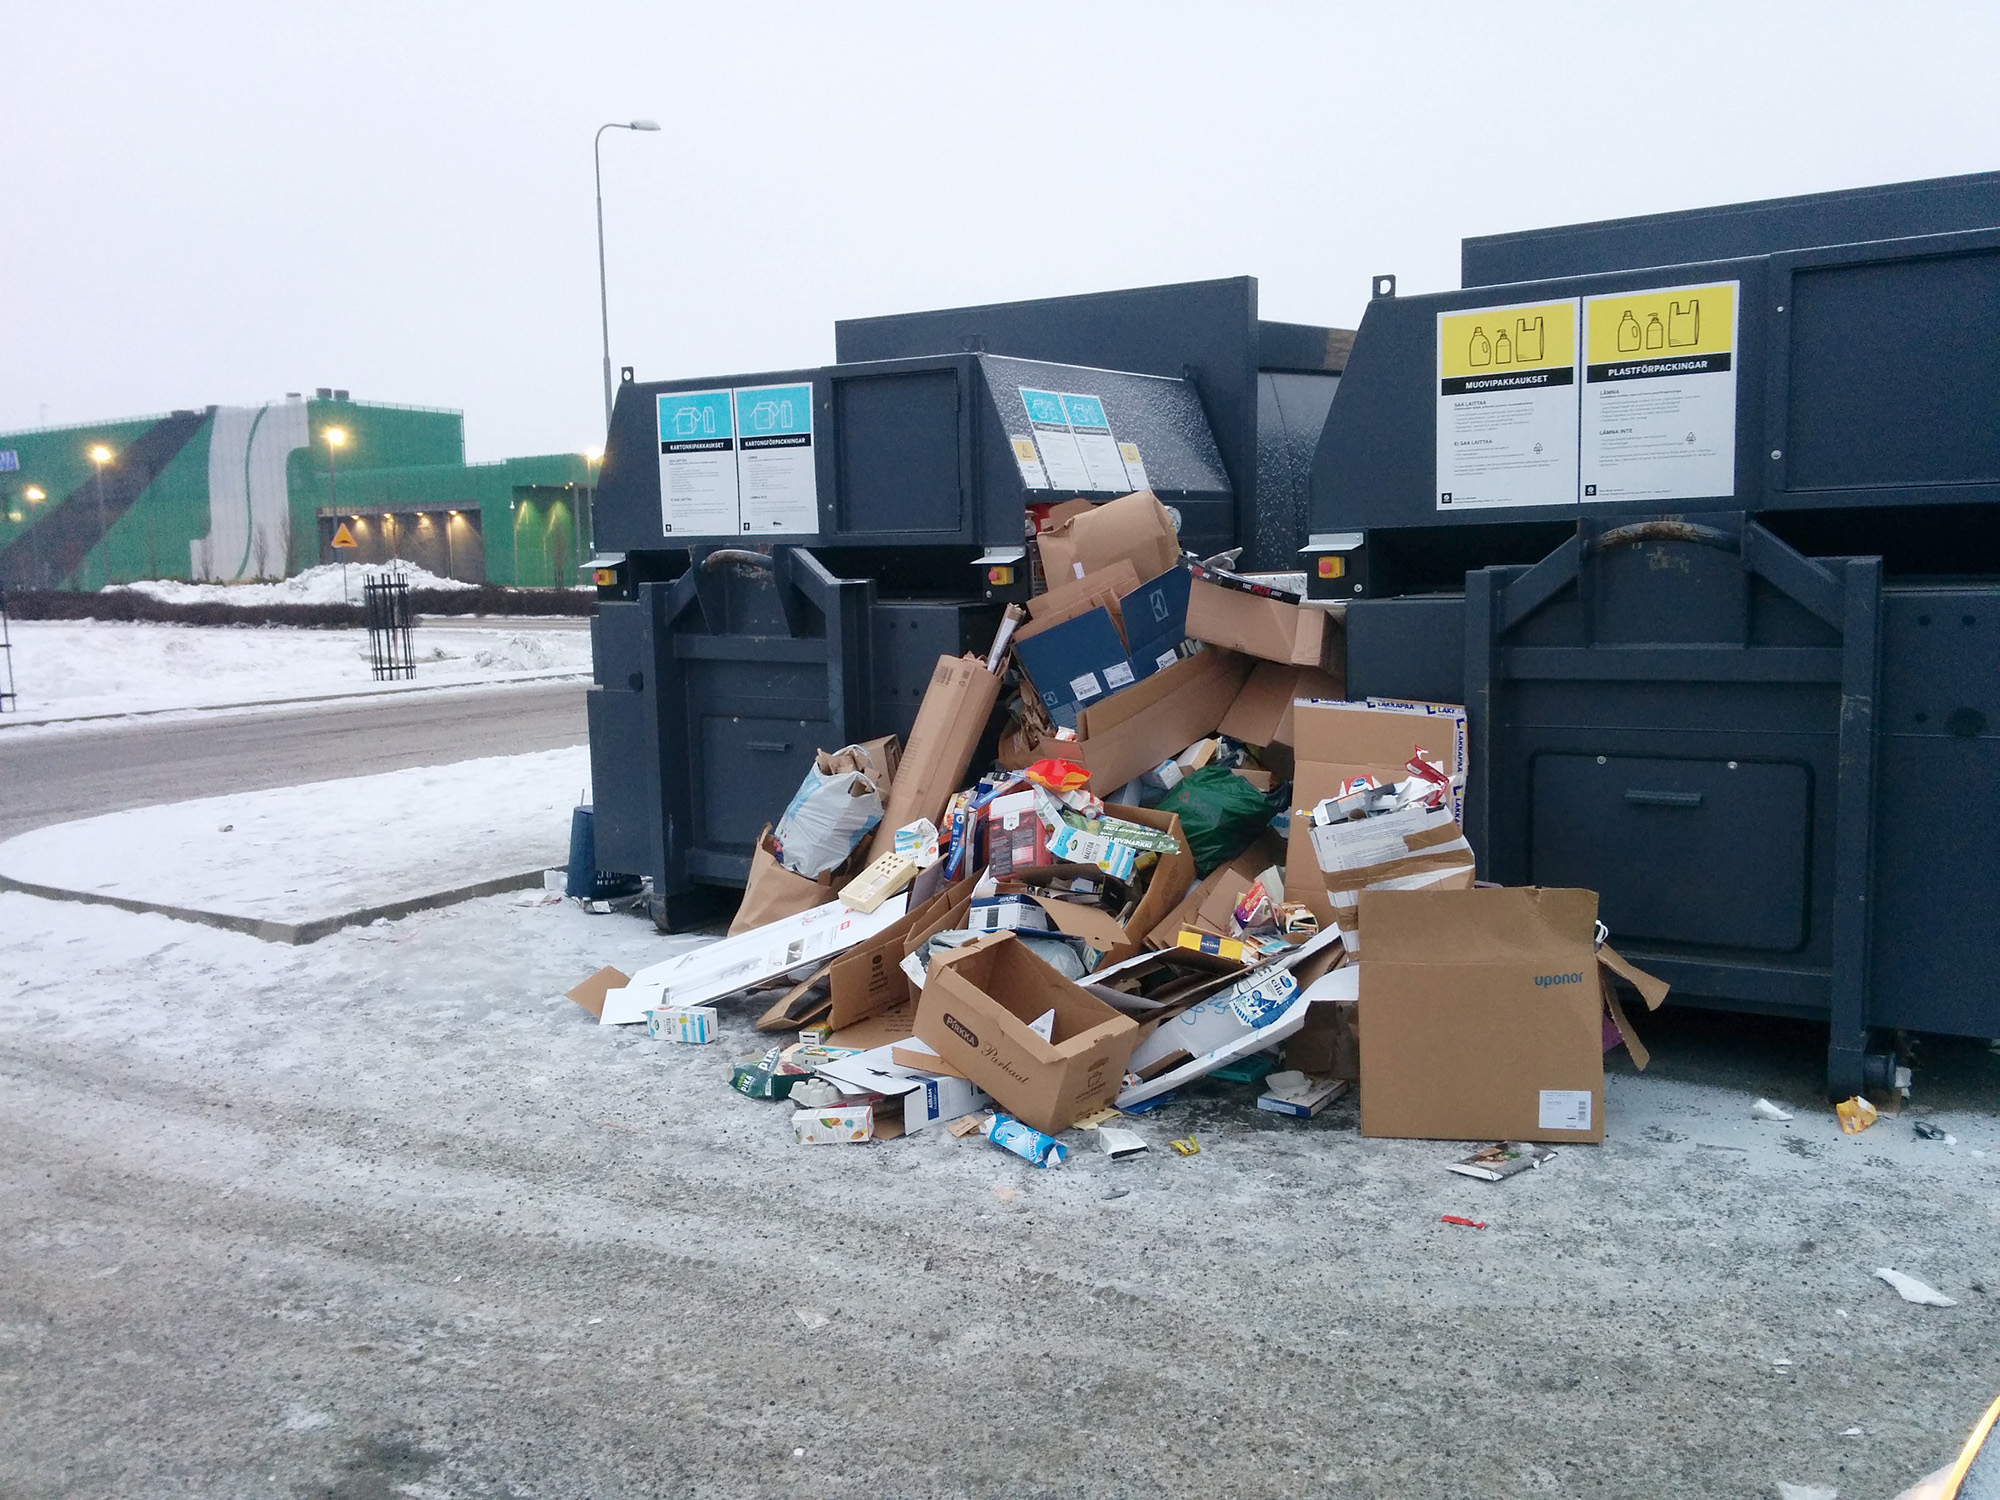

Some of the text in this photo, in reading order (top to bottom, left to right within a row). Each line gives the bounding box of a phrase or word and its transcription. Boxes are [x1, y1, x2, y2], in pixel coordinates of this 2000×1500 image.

[1608, 360, 1708, 377] PLASTFÖRPACKINGAR
[1465, 375, 1549, 389] MUOVIPAKKAUKSET
[670, 442, 725, 451] KARTONKIPAKKAUKSET
[1534, 972, 1584, 988] uponor
[981, 1041, 1030, 1085] Parhaat
[740, 1075, 753, 1092] PIKA
